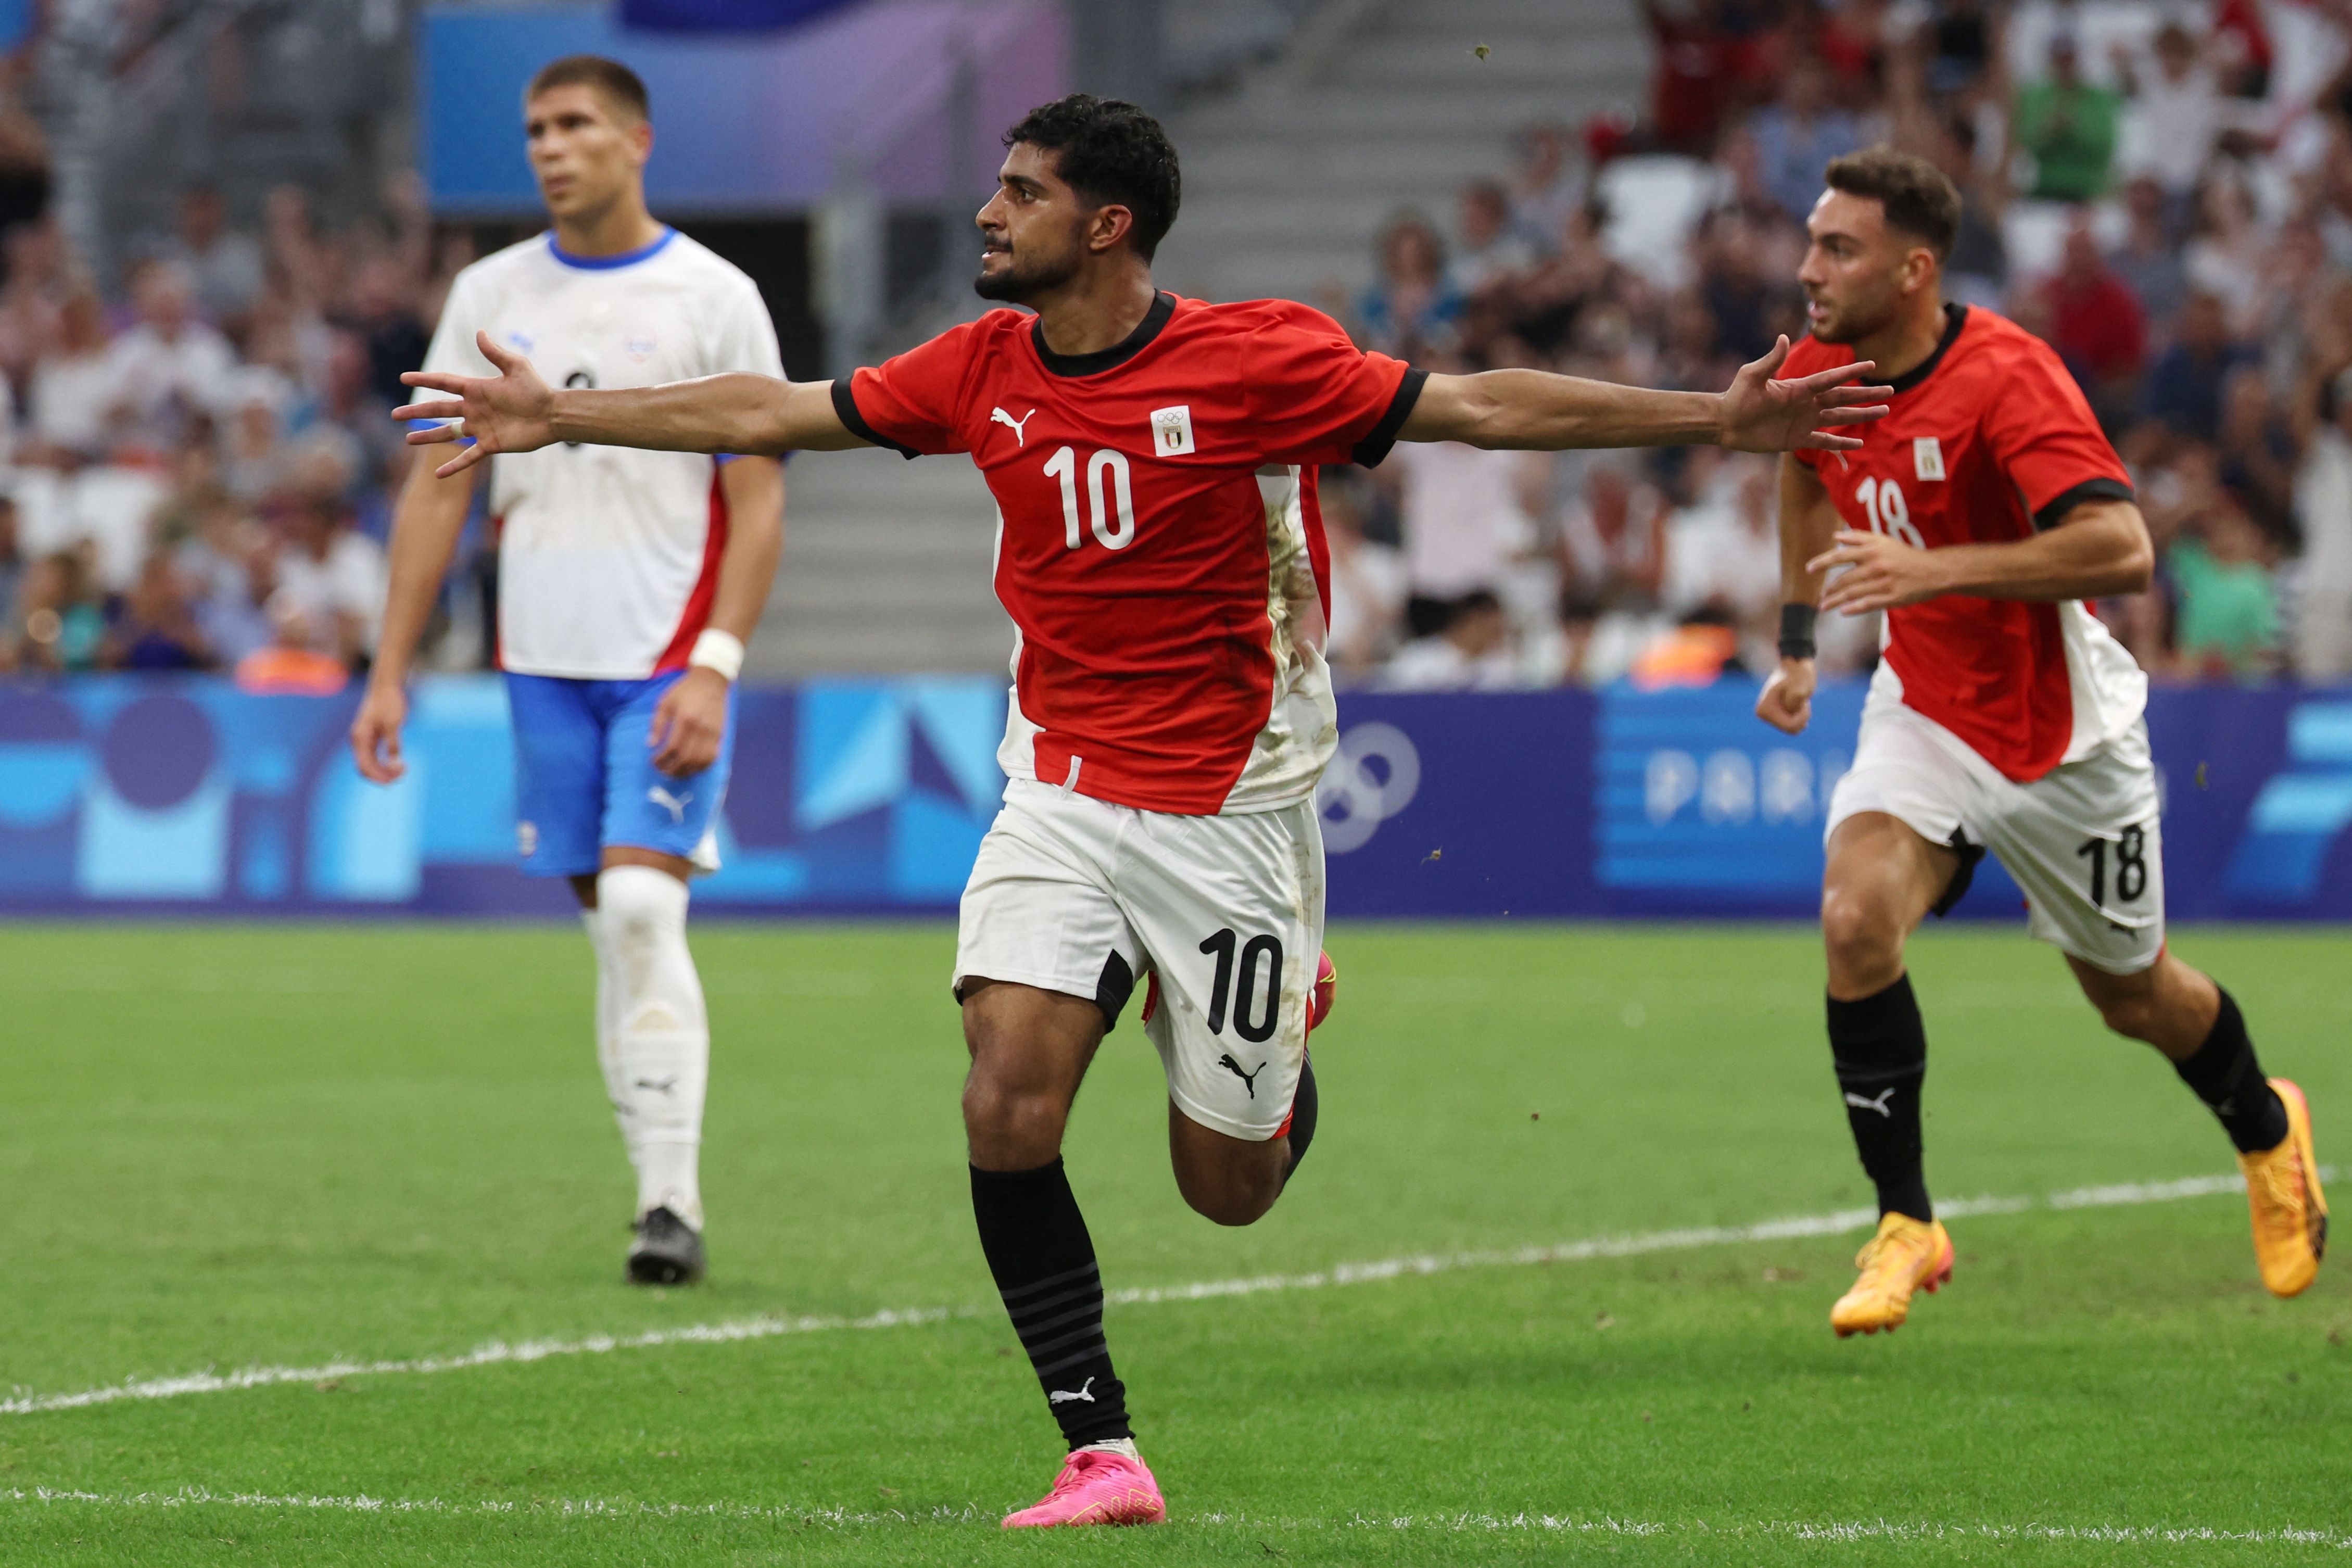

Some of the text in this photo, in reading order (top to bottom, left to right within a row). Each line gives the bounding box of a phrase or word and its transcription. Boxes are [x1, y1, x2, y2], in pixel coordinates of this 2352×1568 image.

[1043, 446, 1135, 550] 10
[1855, 475, 1927, 550] 18
[2078, 823, 2146, 907] 18
[1199, 928, 1283, 1043] 10
